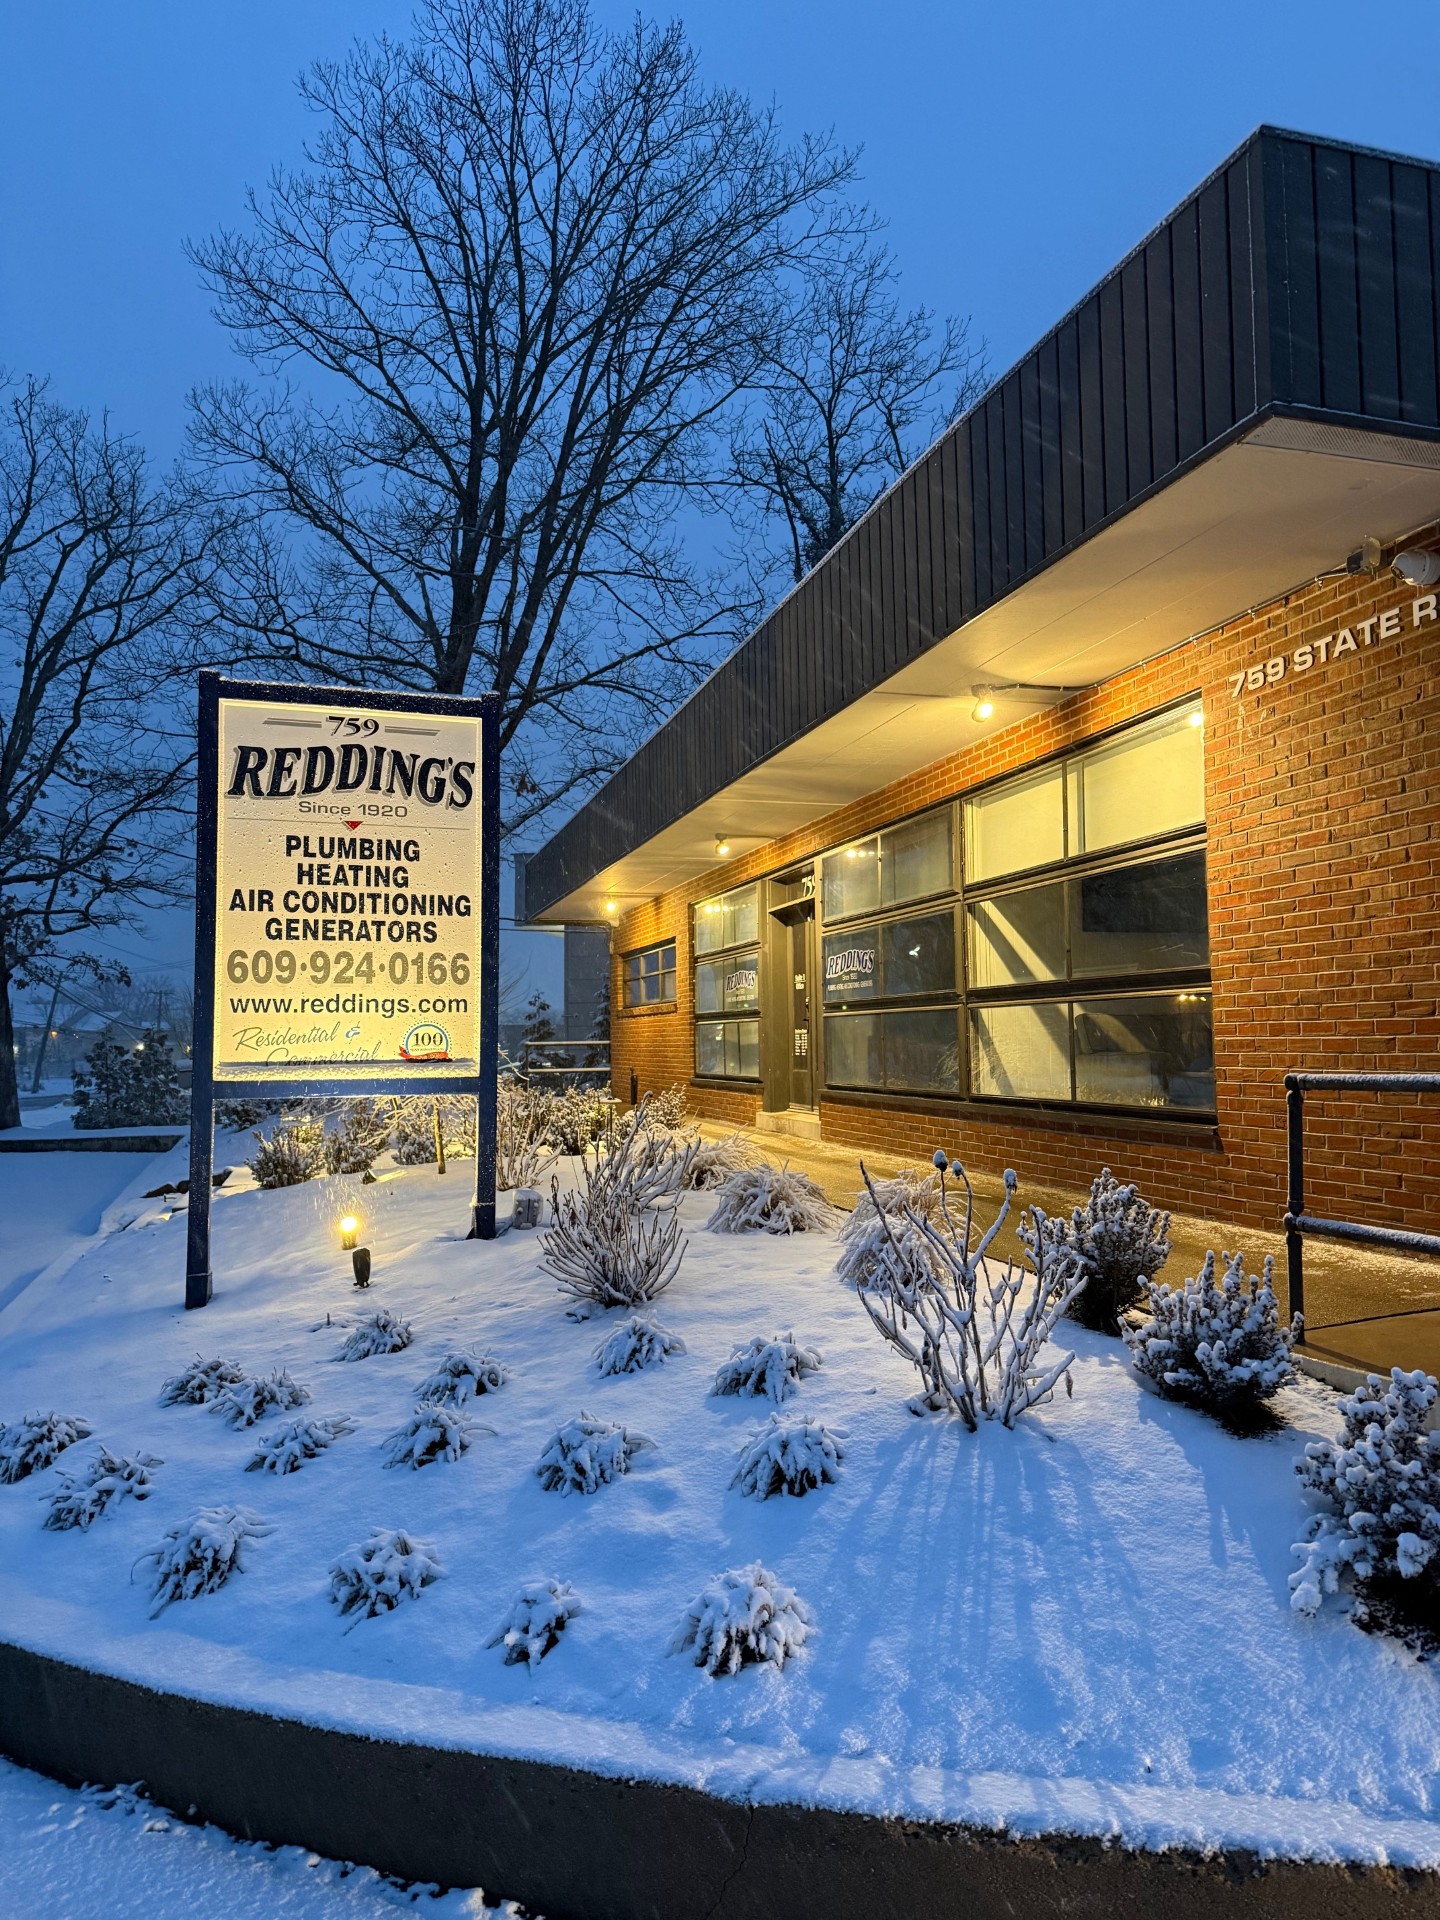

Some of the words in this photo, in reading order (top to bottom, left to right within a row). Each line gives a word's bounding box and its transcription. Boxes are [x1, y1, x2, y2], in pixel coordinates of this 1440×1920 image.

[1229, 656, 1285, 698] 759
[1293, 608, 1401, 673] STATE
[326, 715, 380, 738] 759
[226, 743, 476, 810] REDDING'S
[298, 801, 351, 816] Since
[358, 803, 408, 818] 1920
[285, 834, 420, 862] PLUMBING
[296, 862, 409, 888] HEATING
[229, 889, 274, 912] AIR
[283, 890, 472, 917] CONDITIONING
[265, 918, 438, 943] GENERATORS
[230, 994, 469, 1019] www.reddings.com
[232, 1021, 341, 1051] Residential
[345, 1021, 361, 1045] &
[413, 1032, 444, 1046] 100
